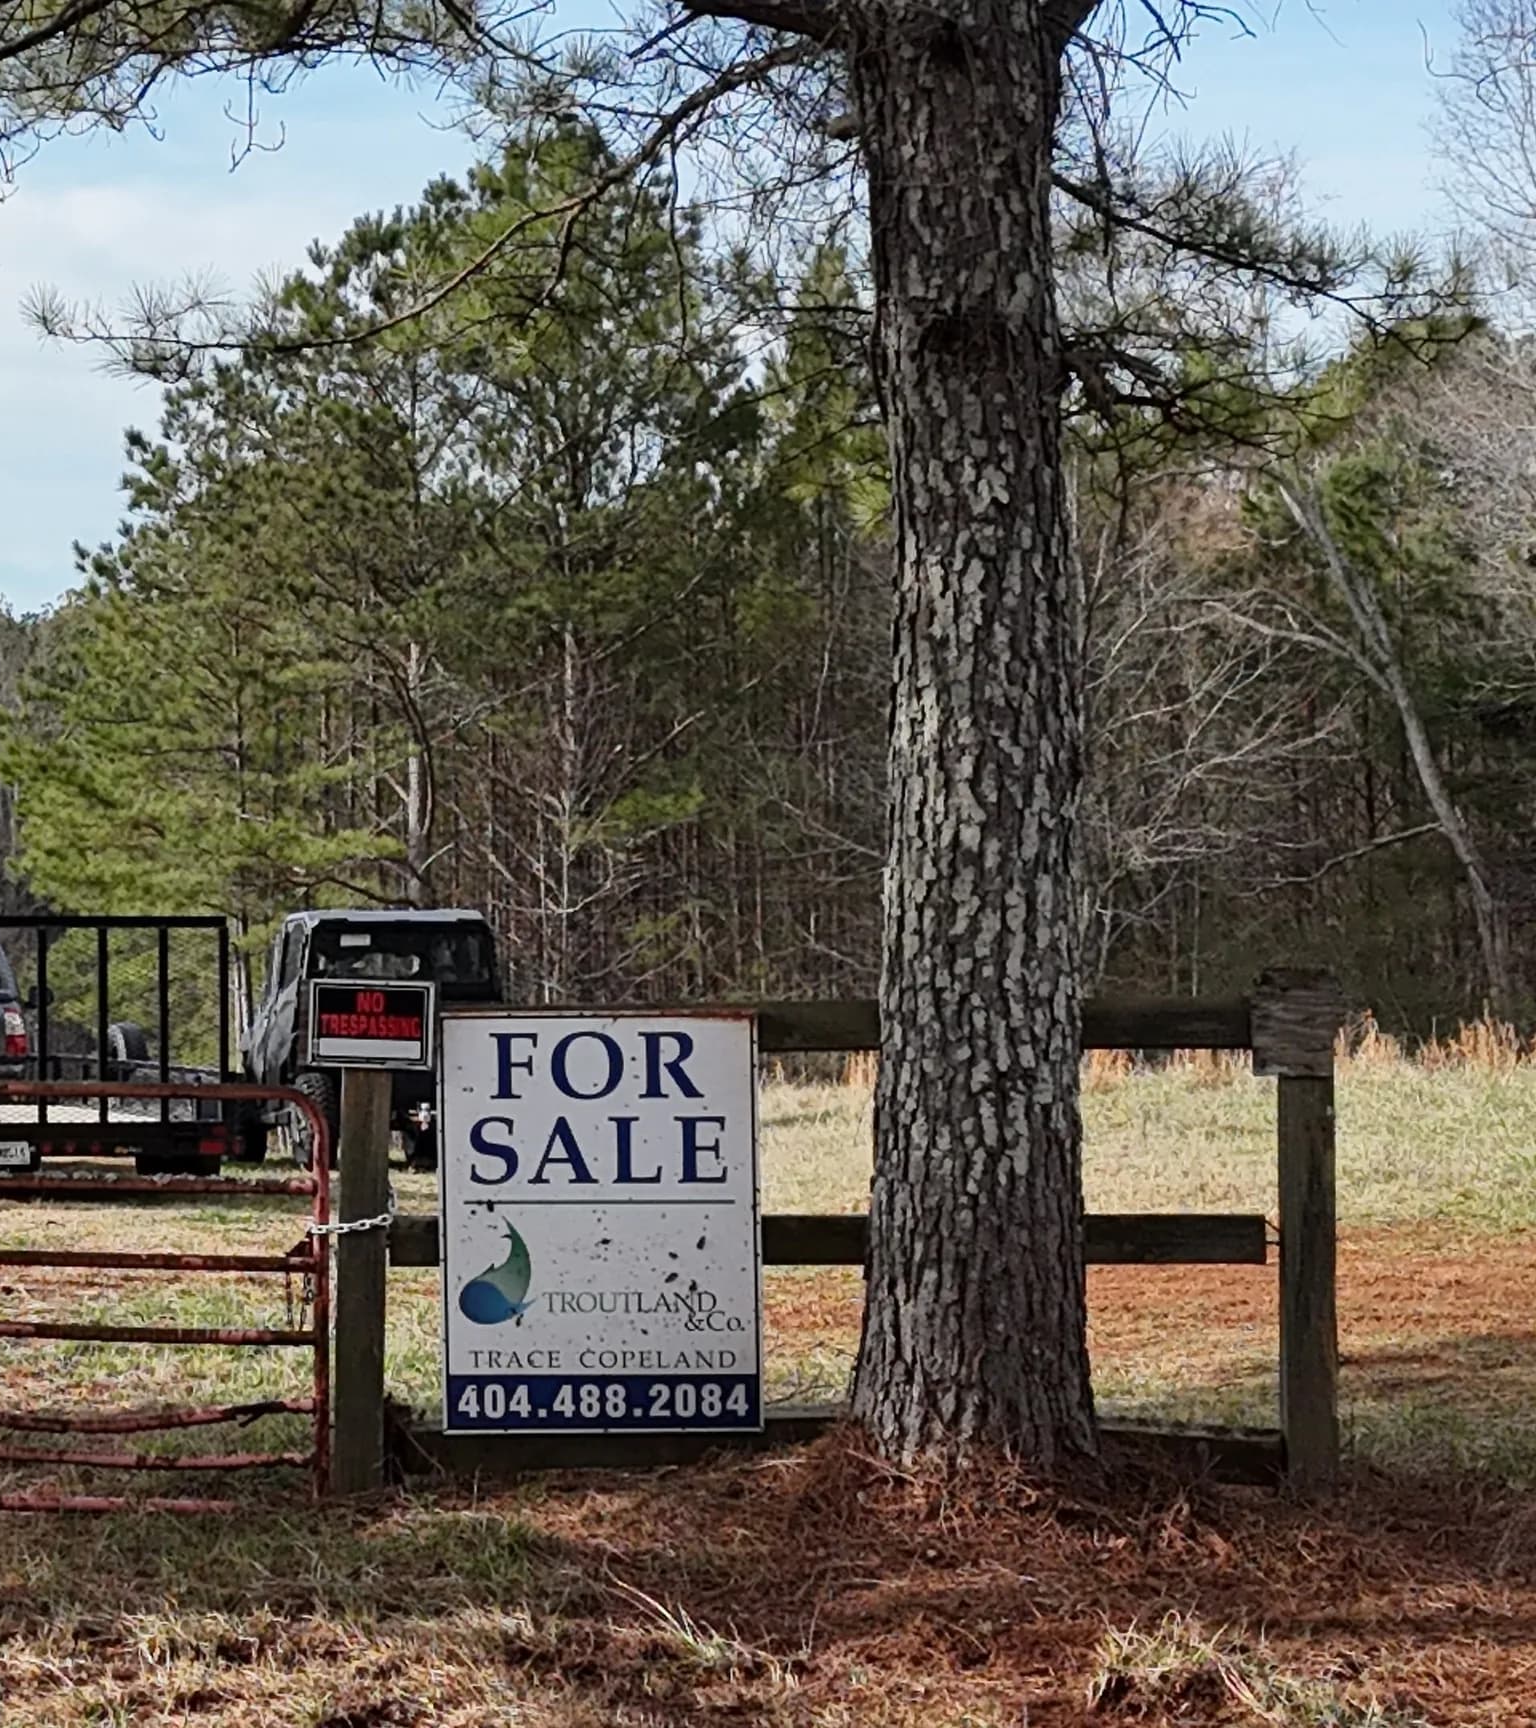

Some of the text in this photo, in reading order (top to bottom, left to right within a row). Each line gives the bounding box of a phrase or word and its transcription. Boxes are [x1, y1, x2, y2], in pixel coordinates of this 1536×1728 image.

[357, 992, 385, 1013] NO
[320, 1014, 421, 1038] TRESPASSING
[489, 1031, 705, 1100] FOR
[469, 1116, 729, 1186] SALE
[542, 1291, 718, 1316] TROUTLAND
[684, 1311, 746, 1332] &Co.
[469, 1349, 737, 1369] TRACE COPELAND
[457, 1383, 749, 1419] 404.488.2084
